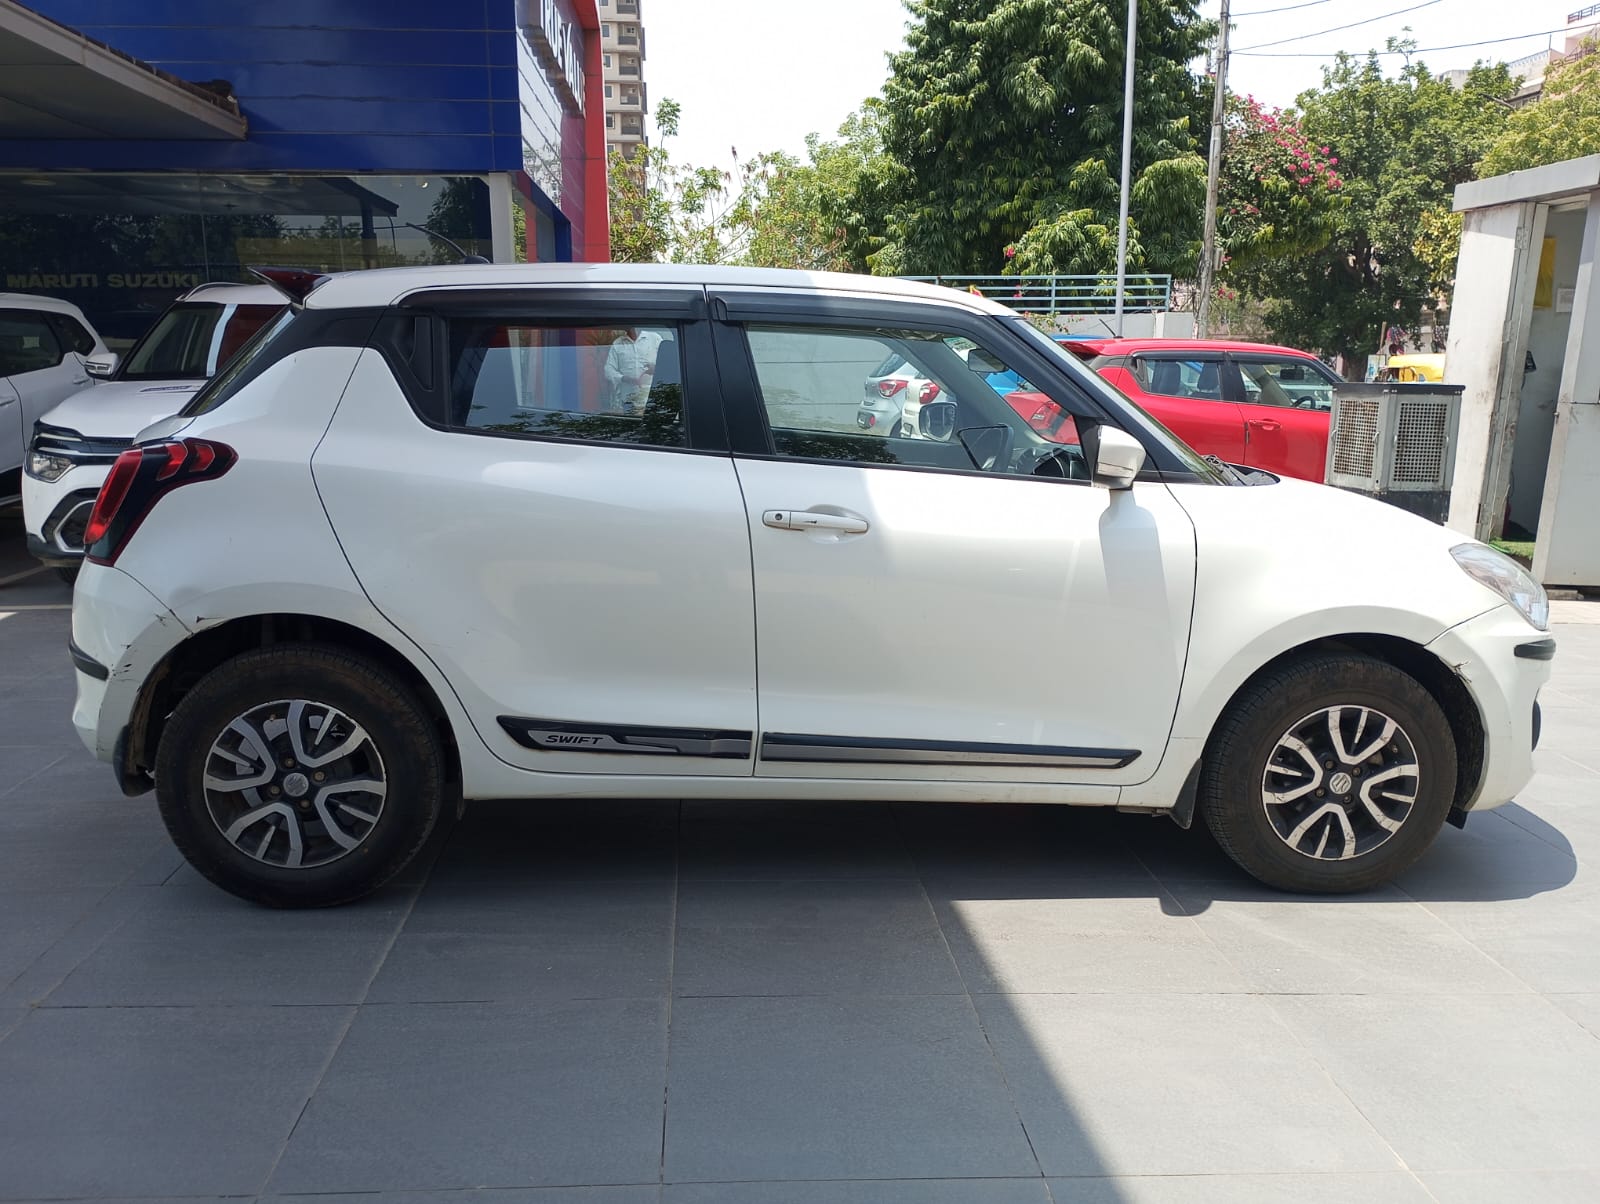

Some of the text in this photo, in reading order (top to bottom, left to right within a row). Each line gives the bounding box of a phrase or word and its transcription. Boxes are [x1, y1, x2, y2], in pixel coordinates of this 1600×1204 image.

[6, 272, 200, 288] MARUTI SUZUKI
[545, 735, 604, 745] SWIFT
